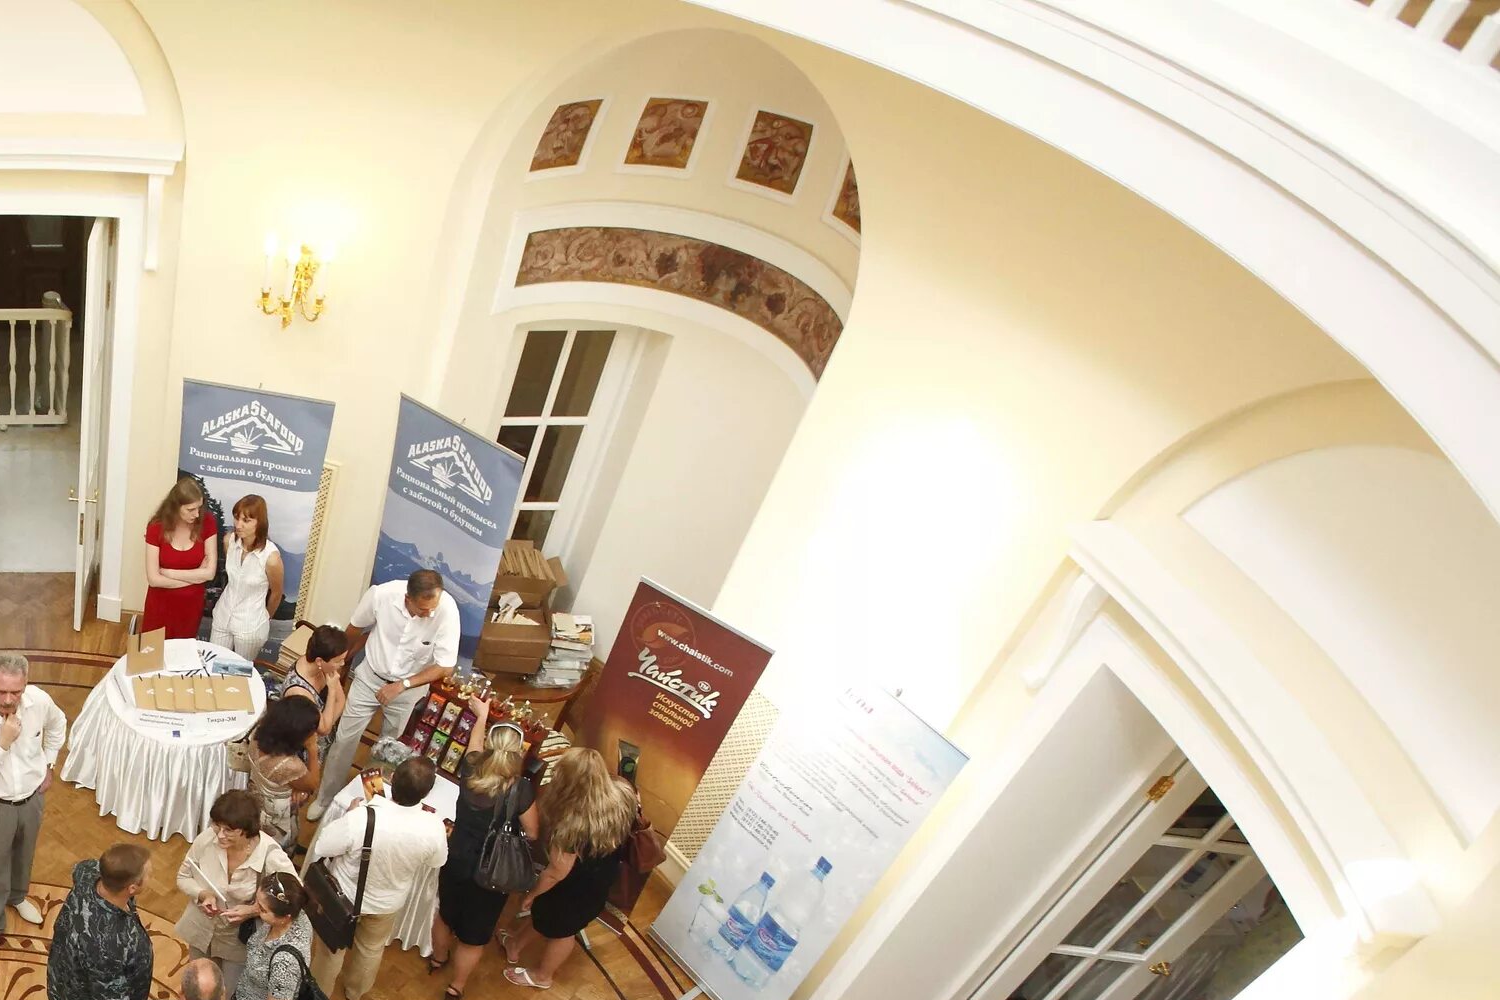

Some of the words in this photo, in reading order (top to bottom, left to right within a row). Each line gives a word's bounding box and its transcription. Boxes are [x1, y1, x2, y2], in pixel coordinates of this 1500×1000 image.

[201, 405, 249, 436] ALASKA
[251, 400, 304, 452] SEAFOOD
[189, 447, 261, 466] Рациональный
[263, 461, 311, 475] промысел
[207, 464, 245, 476] заботой
[255, 471, 297, 486] будущем
[407, 437, 451, 458] ALASKA
[452, 435, 492, 501] SEAFOOD
[396, 466, 455, 505] Рациональный
[456, 501, 497, 530] промысел
[409, 488, 442, 511] заботой
[449, 509, 483, 536] будущем
[657, 629, 734, 677] www.chaistik.com
[636, 647, 720, 712] Чайстик
[648, 709, 682, 731] заварки
[652, 701, 694, 728] стильной
[655, 692, 700, 722] Искусство
